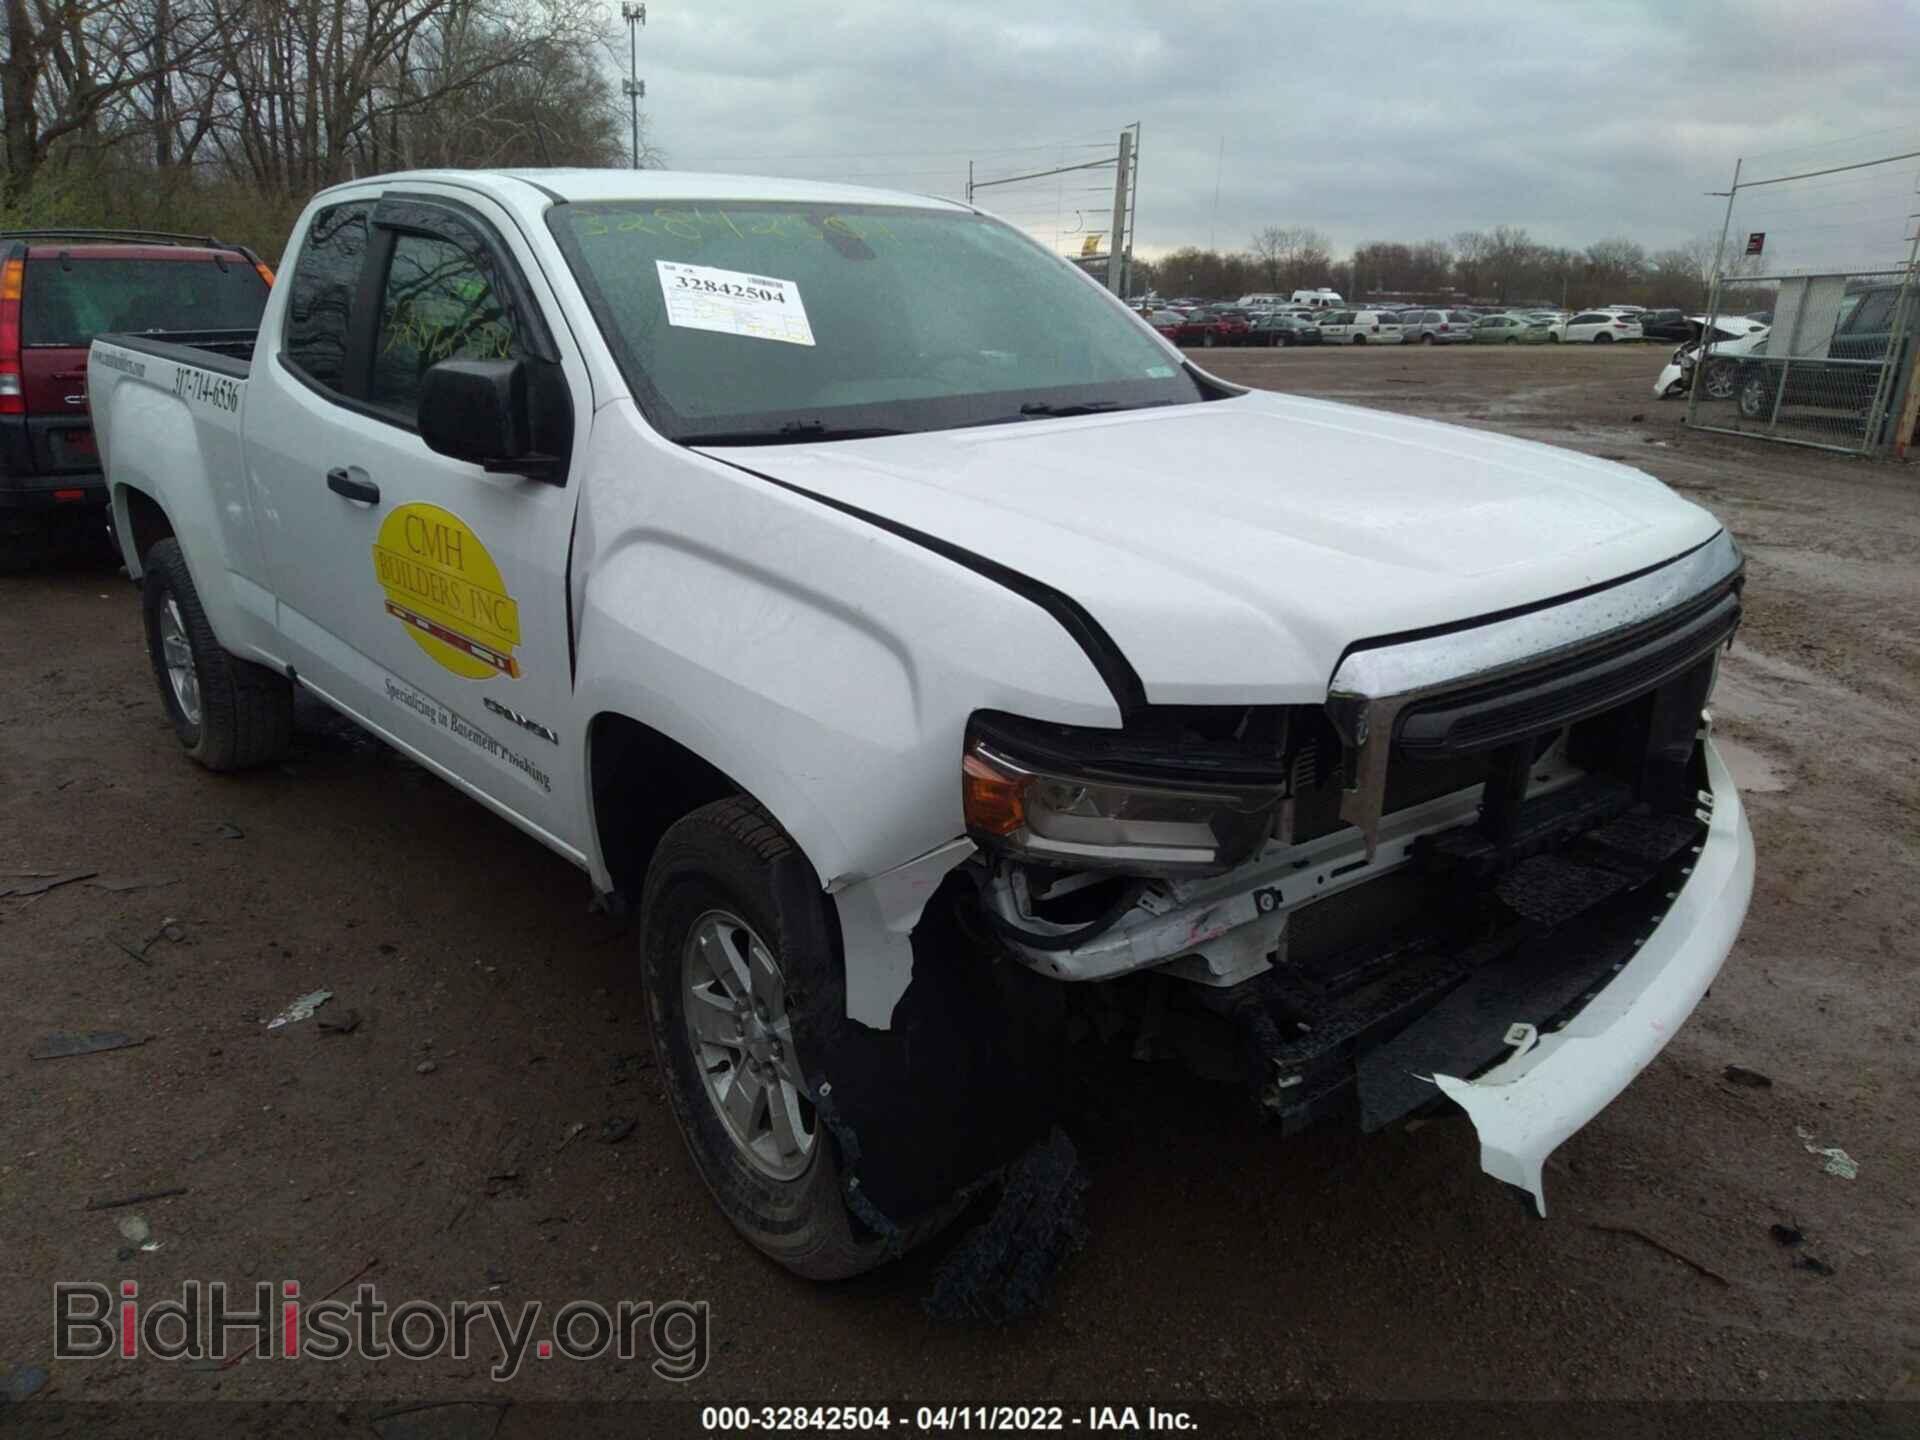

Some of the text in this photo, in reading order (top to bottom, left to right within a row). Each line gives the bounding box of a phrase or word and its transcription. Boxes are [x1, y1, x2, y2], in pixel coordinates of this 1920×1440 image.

[675, 276, 786, 305] 32842504
[173, 367, 239, 413] 317-714-6536
[405, 512, 465, 571] CMH
[384, 678, 437, 726] Specializing
[438, 706, 449, 728] in
[450, 711, 501, 756] Basement
